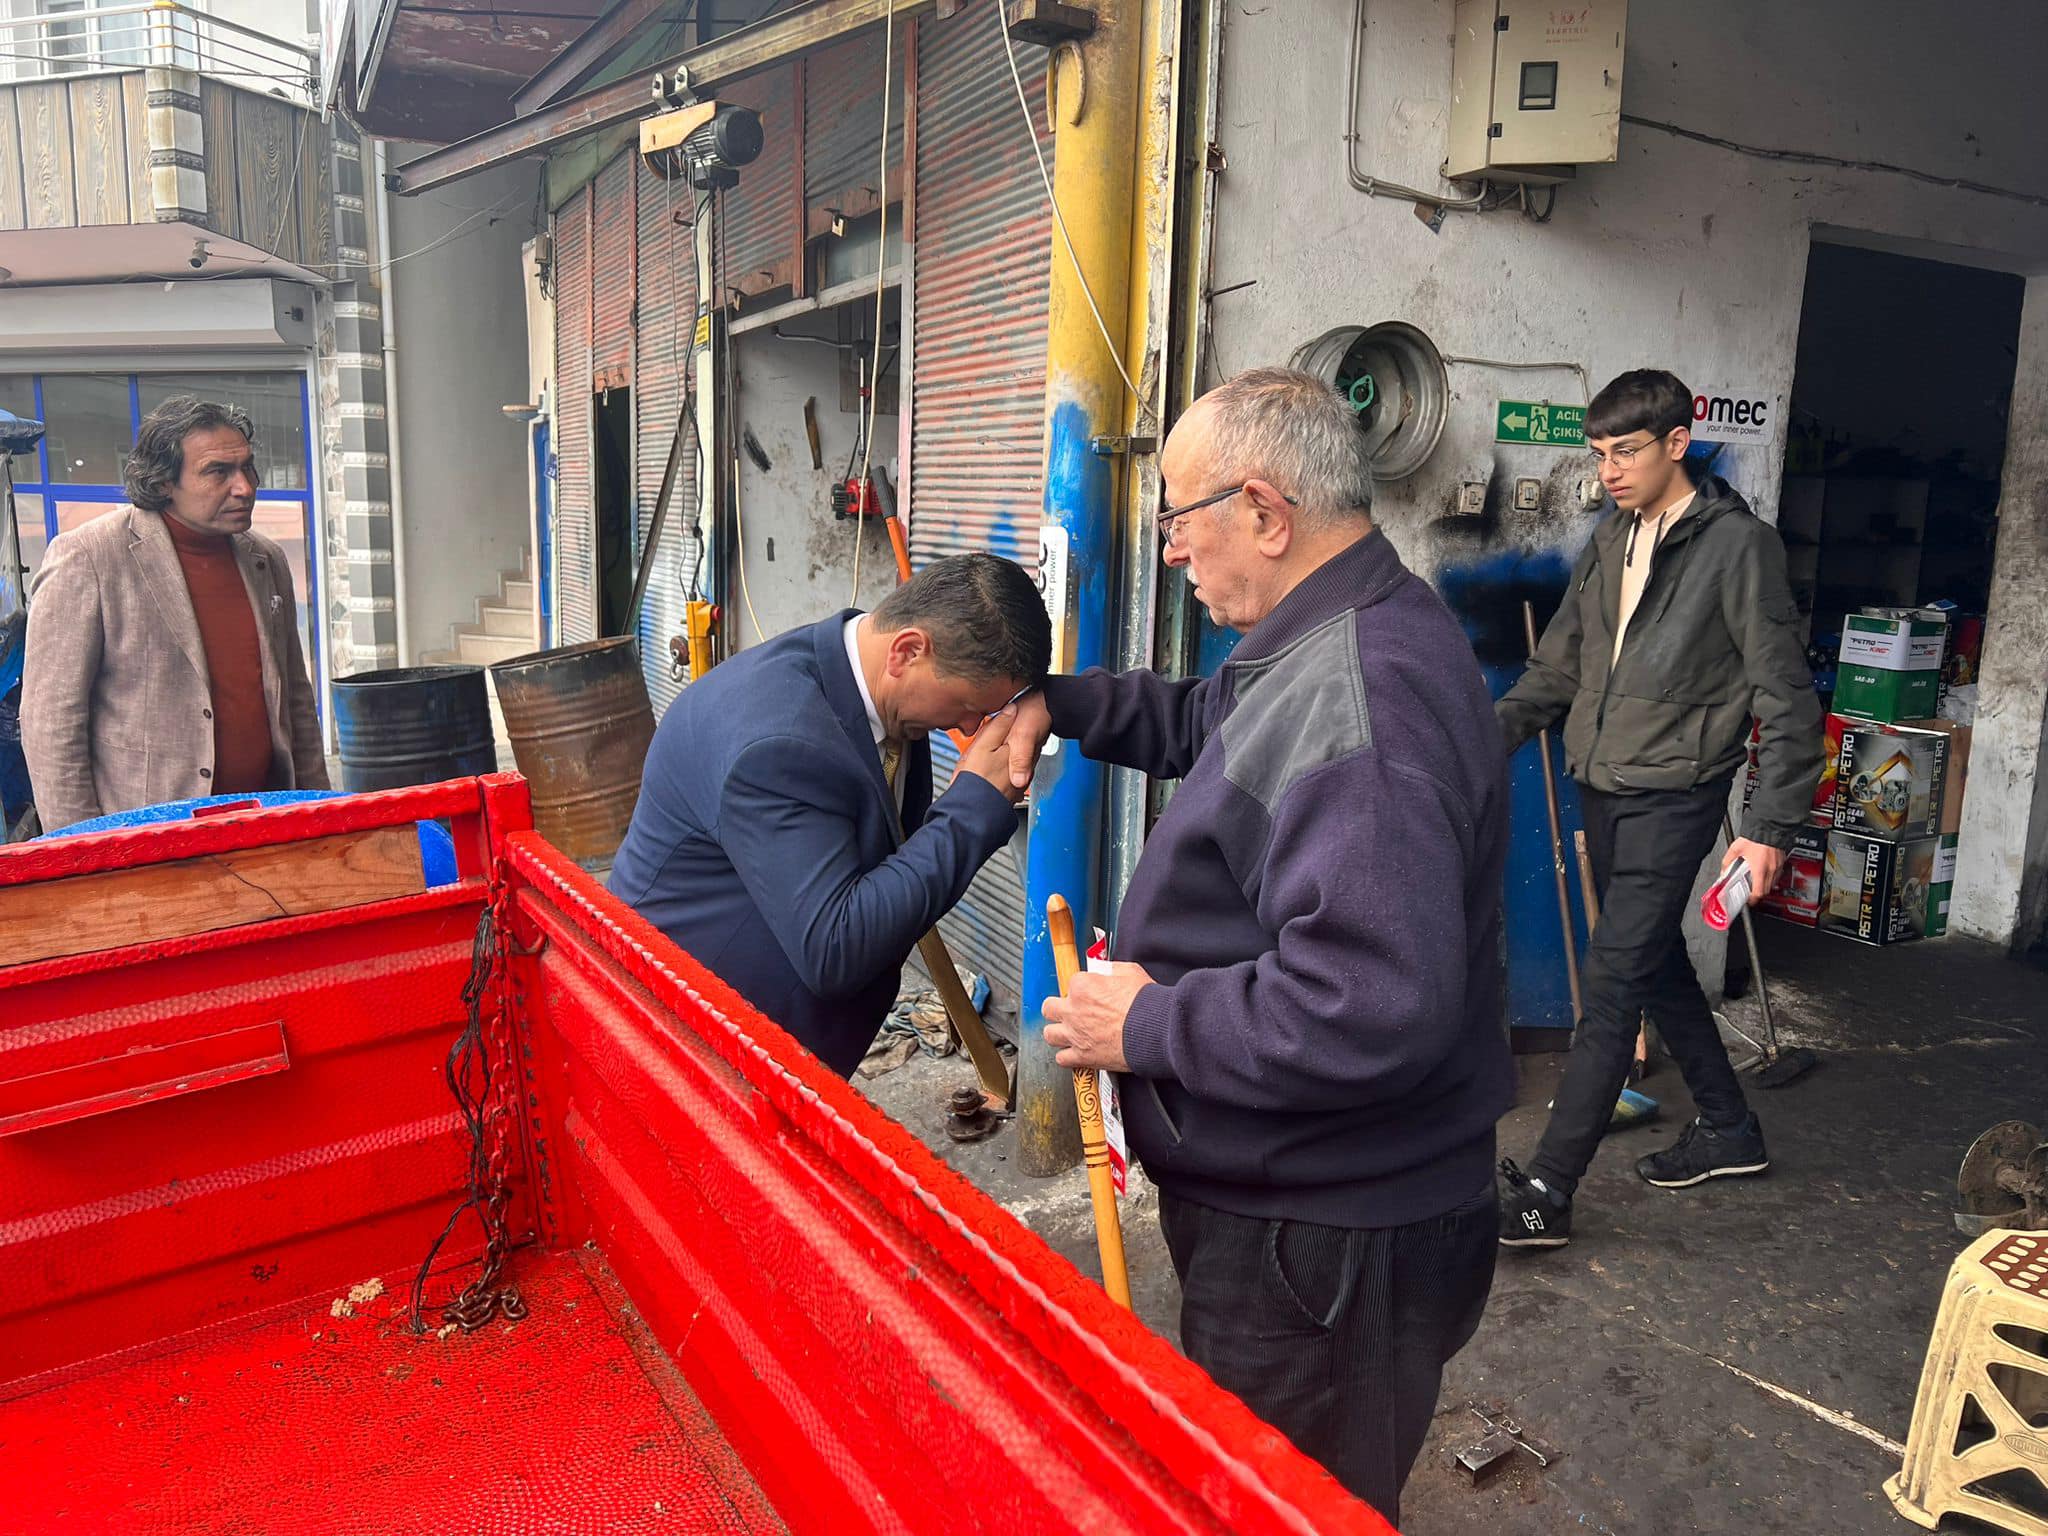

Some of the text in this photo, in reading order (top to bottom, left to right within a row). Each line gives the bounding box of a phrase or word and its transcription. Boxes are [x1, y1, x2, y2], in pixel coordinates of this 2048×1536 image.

[1556, 409, 1582, 422] ACİL
[1553, 426, 1584, 441] ÇIKIŞ
[1706, 425, 1721, 433] your
[1723, 425, 1739, 433] inner
